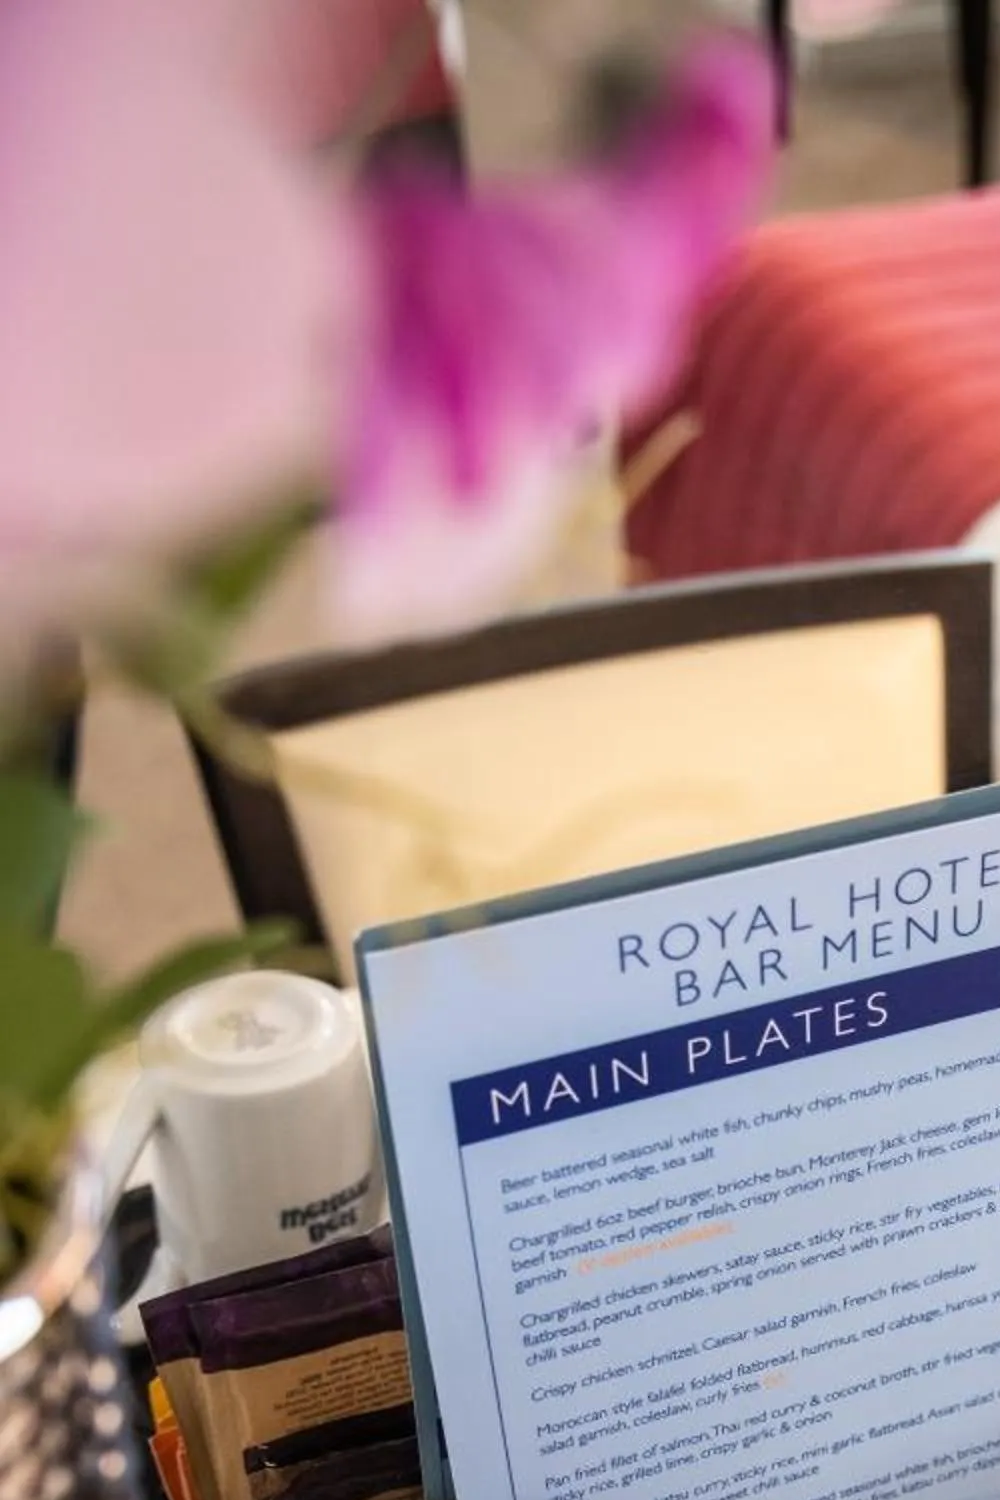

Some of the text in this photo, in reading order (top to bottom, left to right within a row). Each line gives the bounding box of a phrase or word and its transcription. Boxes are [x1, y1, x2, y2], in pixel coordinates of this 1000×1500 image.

[618, 896, 812, 973] ROYAL
[674, 899, 982, 1006] BAR MENU
[491, 991, 887, 1122] MAIN PLATES
[500, 1174, 538, 1194] Beer
[540, 1152, 607, 1183] battered
[610, 1134, 673, 1164] seasonal
[677, 1126, 719, 1145] white
[752, 1103, 803, 1127] chunky
[848, 1080, 894, 1101] mushy
[508, 1217, 592, 1252] Chargrilled
[626, 1197, 661, 1220] beef
[716, 1172, 772, 1195] brioche
[808, 1143, 876, 1170] Monterey
[879, 1133, 906, 1155] Jack
[552, 1178, 602, 1200] lemon
[661, 1156, 687, 1171] sea
[690, 1145, 714, 1162] salt
[510, 1249, 546, 1273] beef
[609, 1225, 636, 1245] red
[638, 1212, 693, 1240] pepper
[738, 1189, 780, 1208] crispy
[782, 1176, 825, 1197] onion
[866, 1151, 913, 1174] French
[519, 1295, 601, 1329] Chargrilled
[604, 1281, 659, 1305] chicken
[806, 1227, 845, 1246] sticky
[904, 1205, 922, 1219] fry
[592, 1304, 642, 1331] peanut
[709, 1272, 753, 1295] spring
[755, 1261, 797, 1280] onion
[799, 1243, 847, 1268] served
[849, 1235, 879, 1253] with
[927, 1206, 983, 1231] crackers
[984, 1201, 996, 1214] &
[514, 1267, 567, 1295] garnish
[530, 1380, 577, 1402] Crispy
[580, 1364, 634, 1387] chicken
[701, 1329, 751, 1350] Caesar
[753, 1315, 787, 1337] salad
[842, 1287, 887, 1310] French
[922, 1262, 976, 1286] coleslaw
[525, 1336, 601, 1367] chilli sauce
